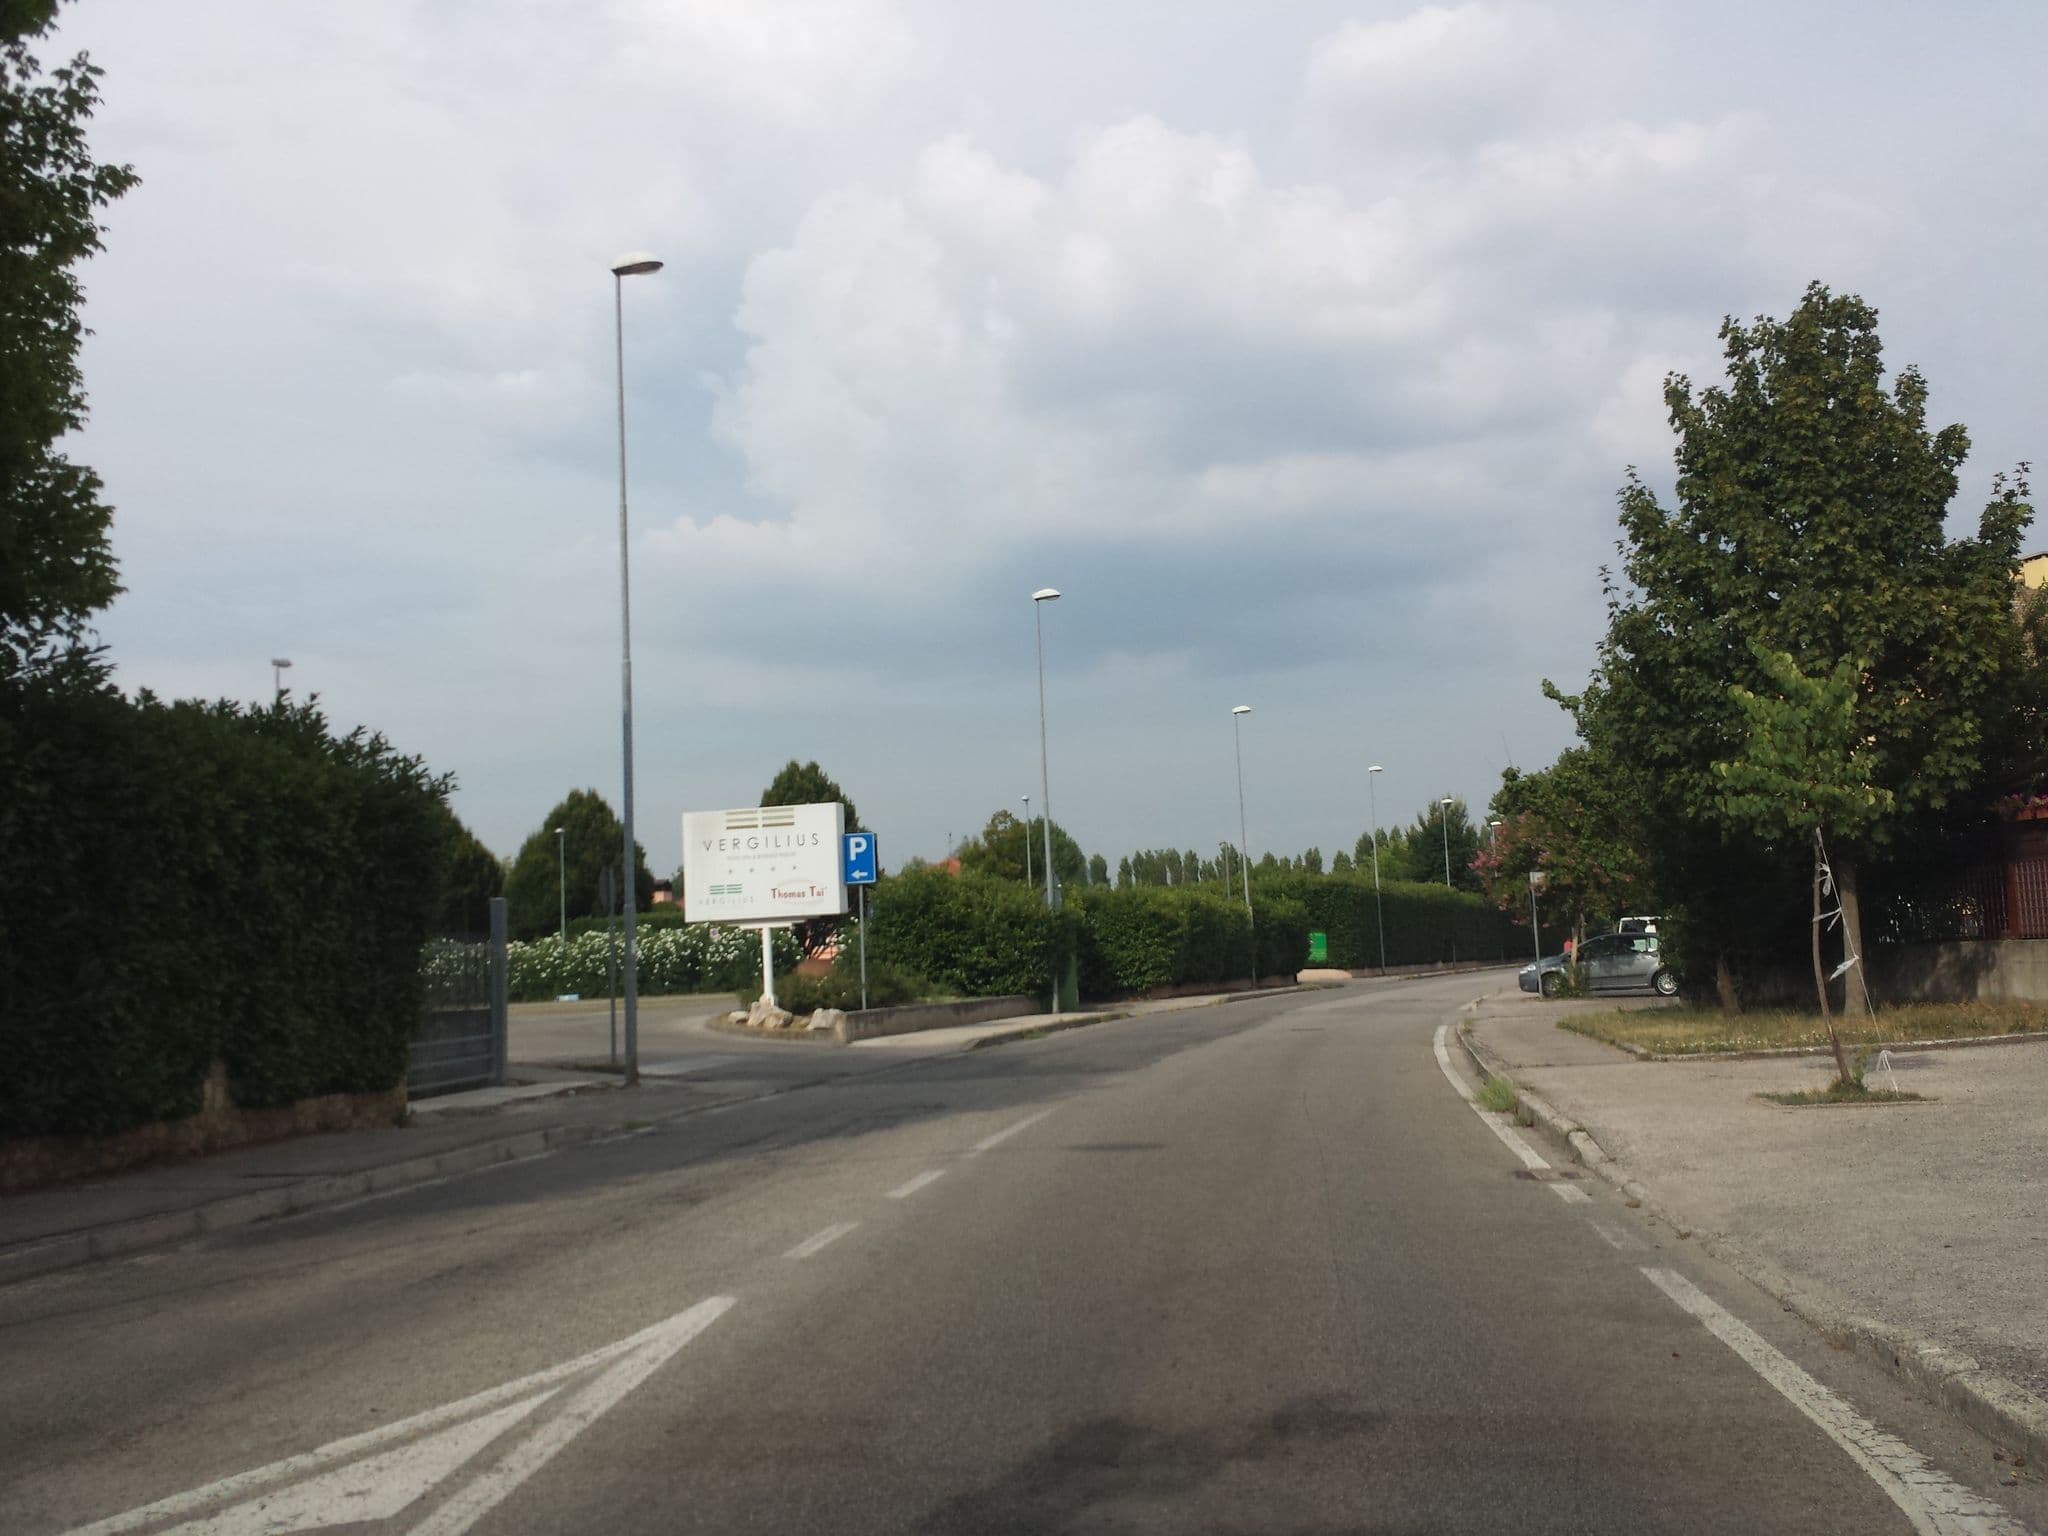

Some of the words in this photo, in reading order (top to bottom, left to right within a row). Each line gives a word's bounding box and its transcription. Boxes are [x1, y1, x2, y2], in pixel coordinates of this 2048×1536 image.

[703, 832, 820, 852] VERGILIUS
[850, 836, 868, 861] P
[770, 887, 807, 900] Thomas
